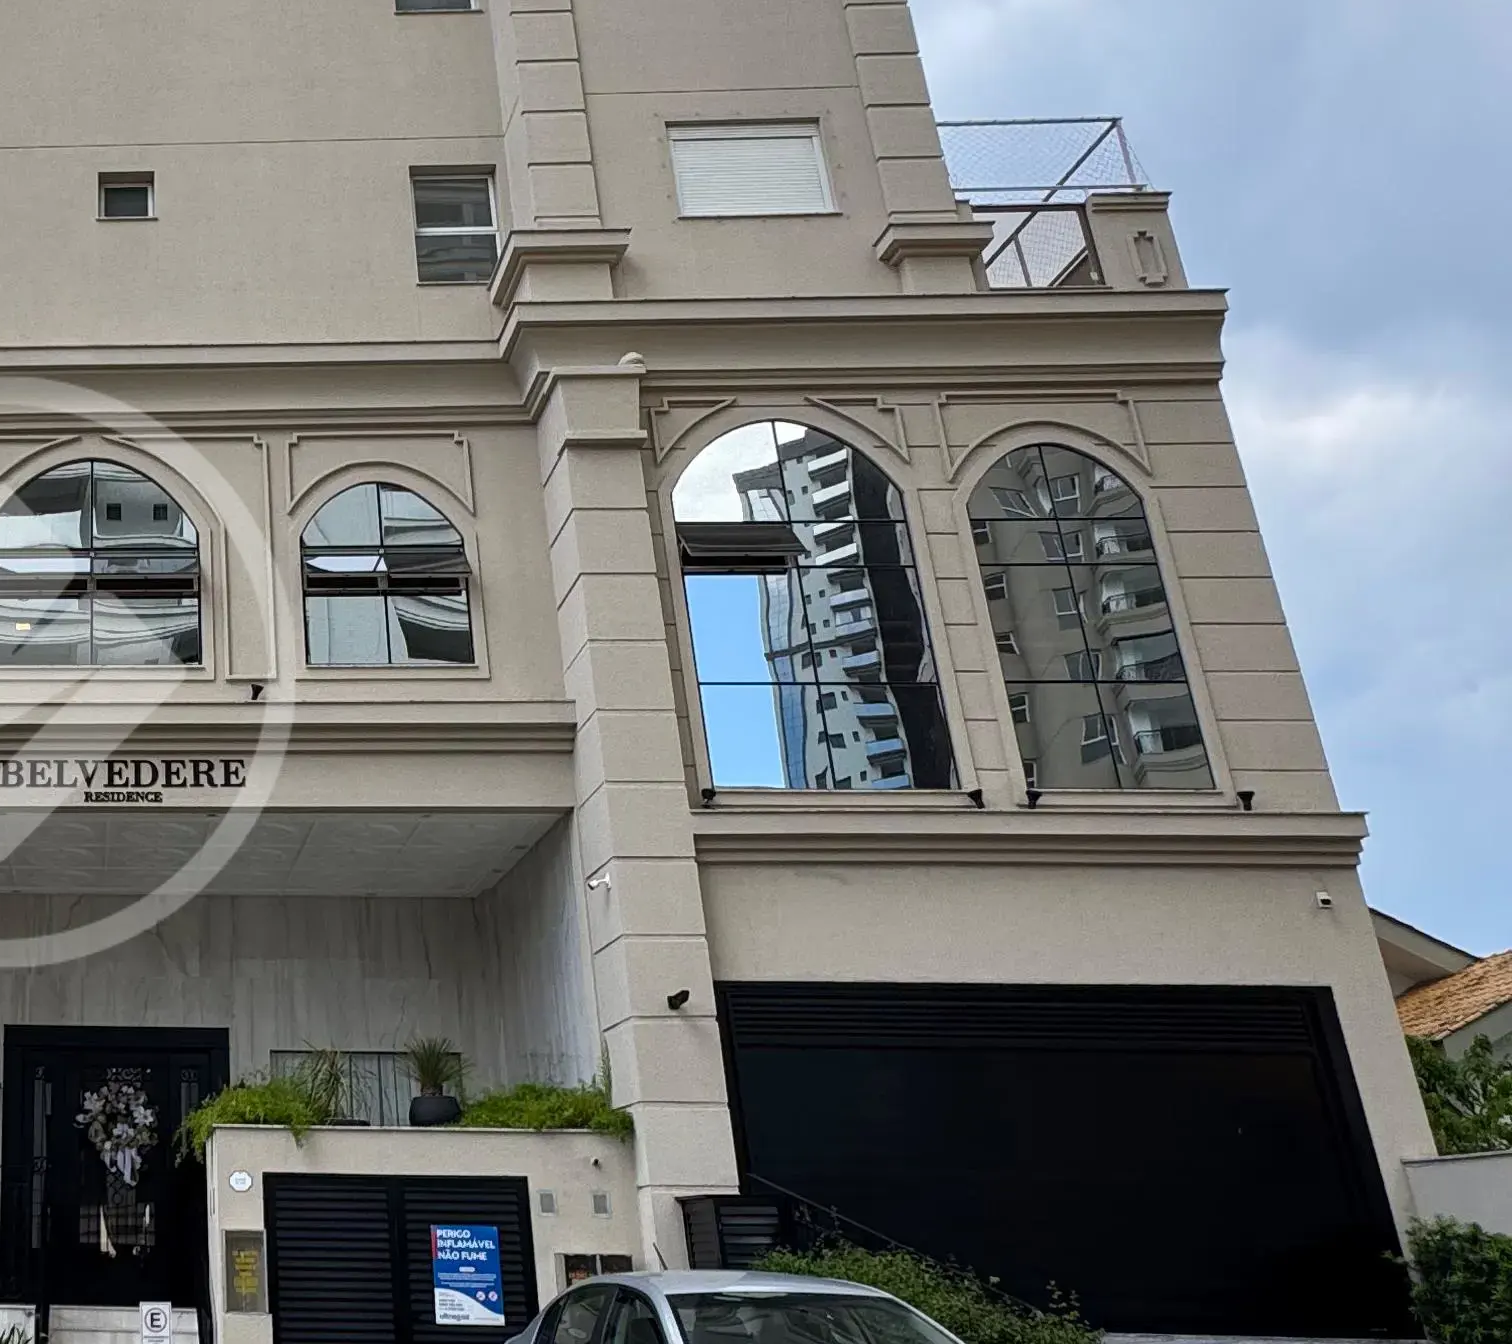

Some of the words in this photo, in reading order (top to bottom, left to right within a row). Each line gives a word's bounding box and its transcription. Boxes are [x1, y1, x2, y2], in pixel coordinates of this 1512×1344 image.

[83, 791, 163, 803] RESIDENCE
[437, 1229, 471, 1238] PERIGO
[437, 1237, 496, 1250] INFLAMÁVEL
[437, 1249, 460, 1261] NÃO
[461, 1251, 488, 1261] FUME
[150, 1312, 162, 1328] E
